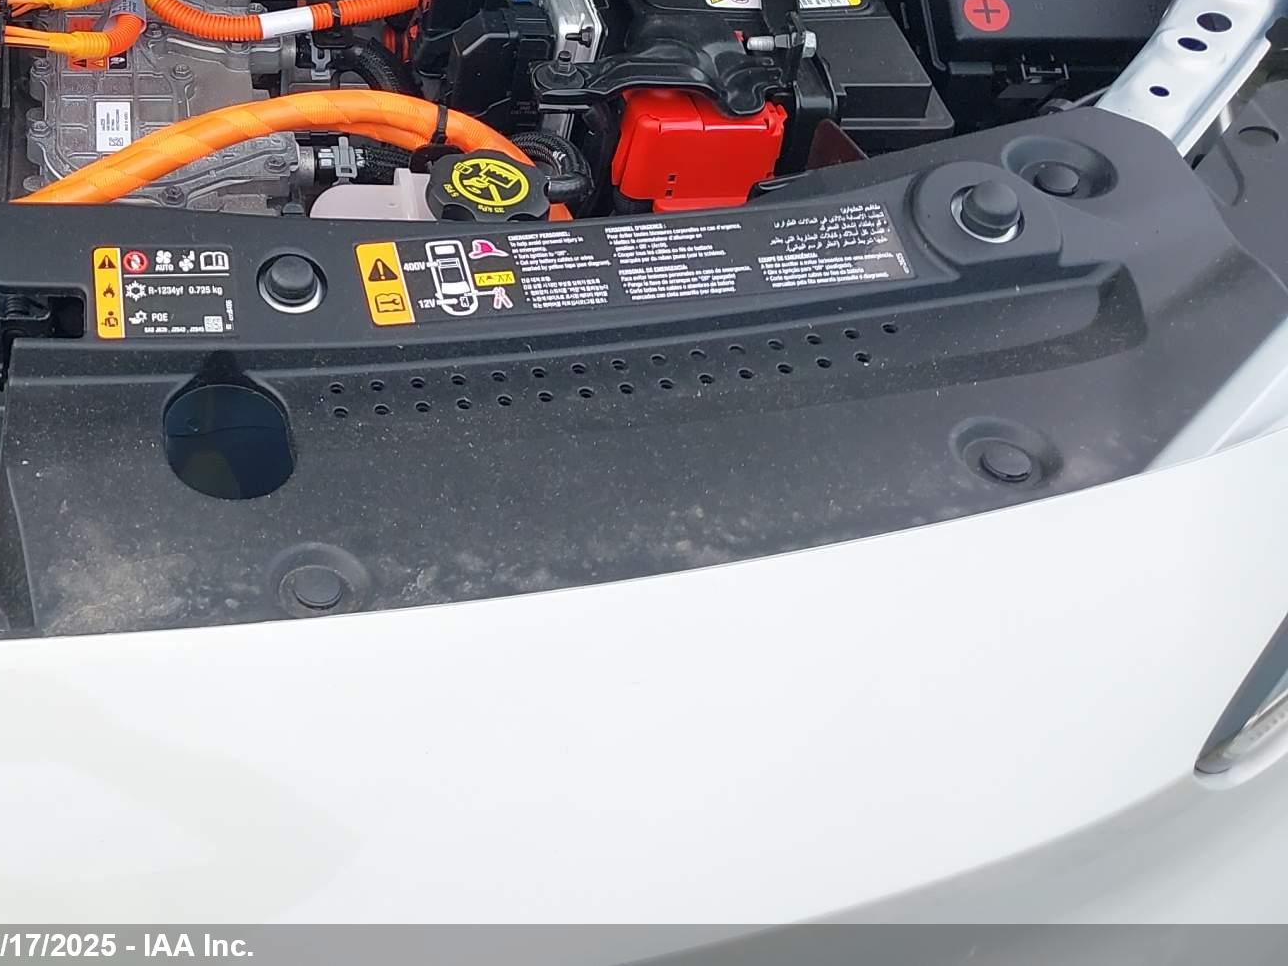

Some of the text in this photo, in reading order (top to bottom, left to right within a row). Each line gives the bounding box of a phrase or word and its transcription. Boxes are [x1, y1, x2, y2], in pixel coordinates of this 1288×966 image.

[404, 262, 426, 271] 400V
[148, 286, 223, 296] R-1234yf 0.725 kg
[418, 299, 435, 309] 12V
